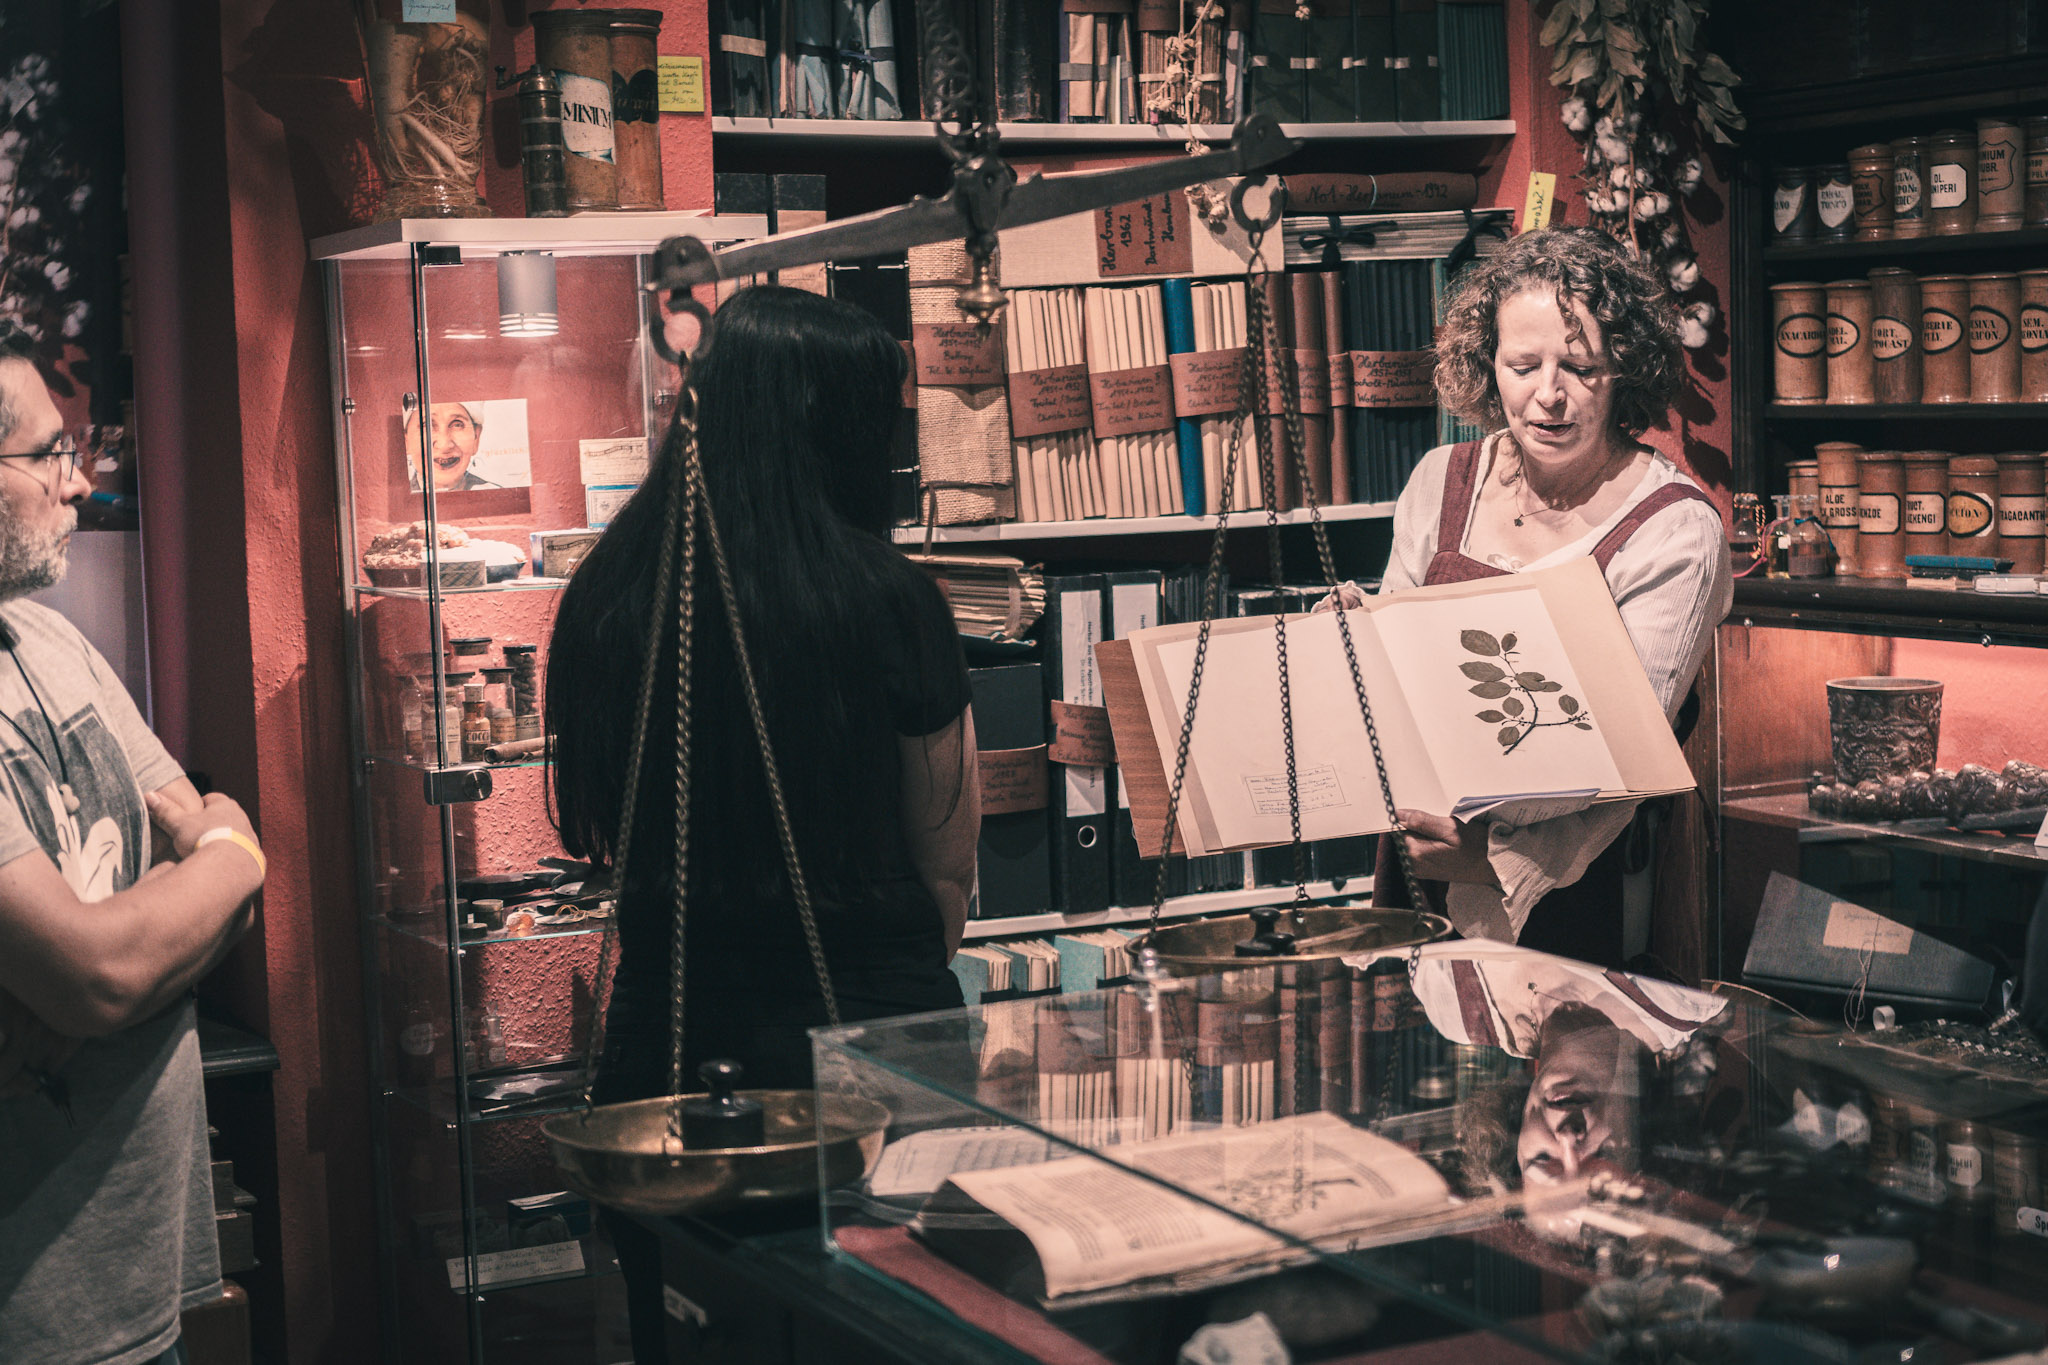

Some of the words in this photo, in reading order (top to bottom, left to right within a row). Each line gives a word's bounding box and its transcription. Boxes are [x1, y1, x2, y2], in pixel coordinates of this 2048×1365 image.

[1119, 213, 1132, 248] 1962
[1825, 494, 1845, 504] ALOE
[1829, 507, 1857, 518] GROSS
